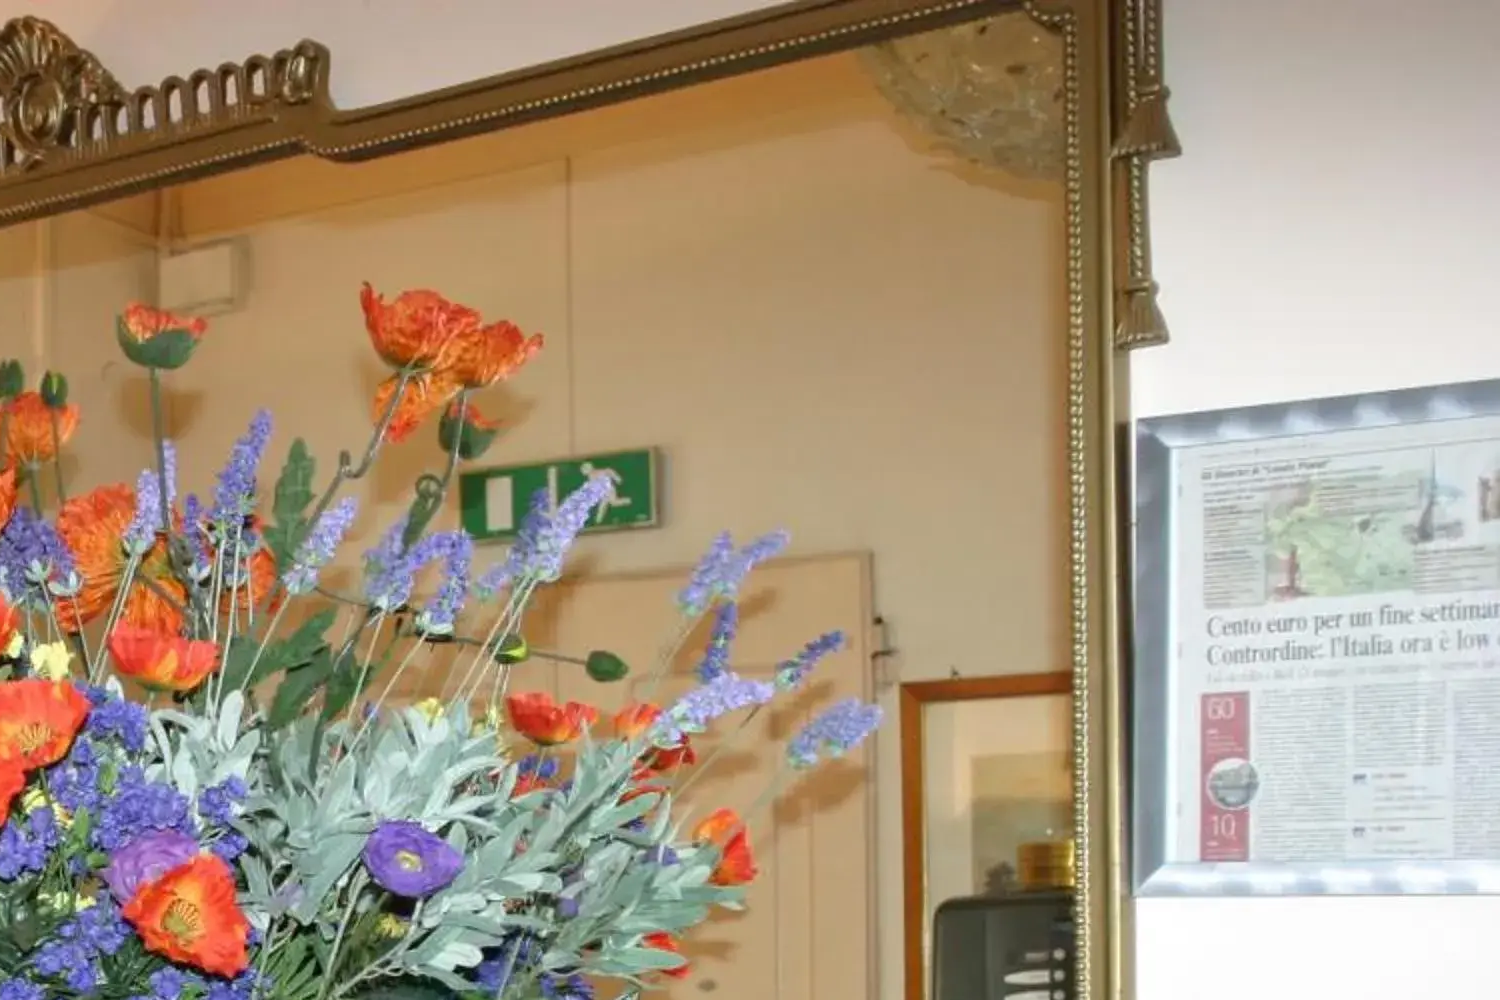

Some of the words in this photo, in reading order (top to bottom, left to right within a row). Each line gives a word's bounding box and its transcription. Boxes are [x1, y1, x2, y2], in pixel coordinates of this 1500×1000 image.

[1206, 615, 1262, 638] Cento
[1266, 616, 1308, 634] euro
[1313, 613, 1343, 636] per
[1349, 611, 1373, 627] un
[1380, 604, 1415, 625] fine
[1206, 640, 1326, 666] Contrordine:
[1400, 637, 1433, 654] ora
[1457, 628, 1490, 651] low
[1207, 698, 1235, 719] 60
[1211, 813, 1236, 838] 10
